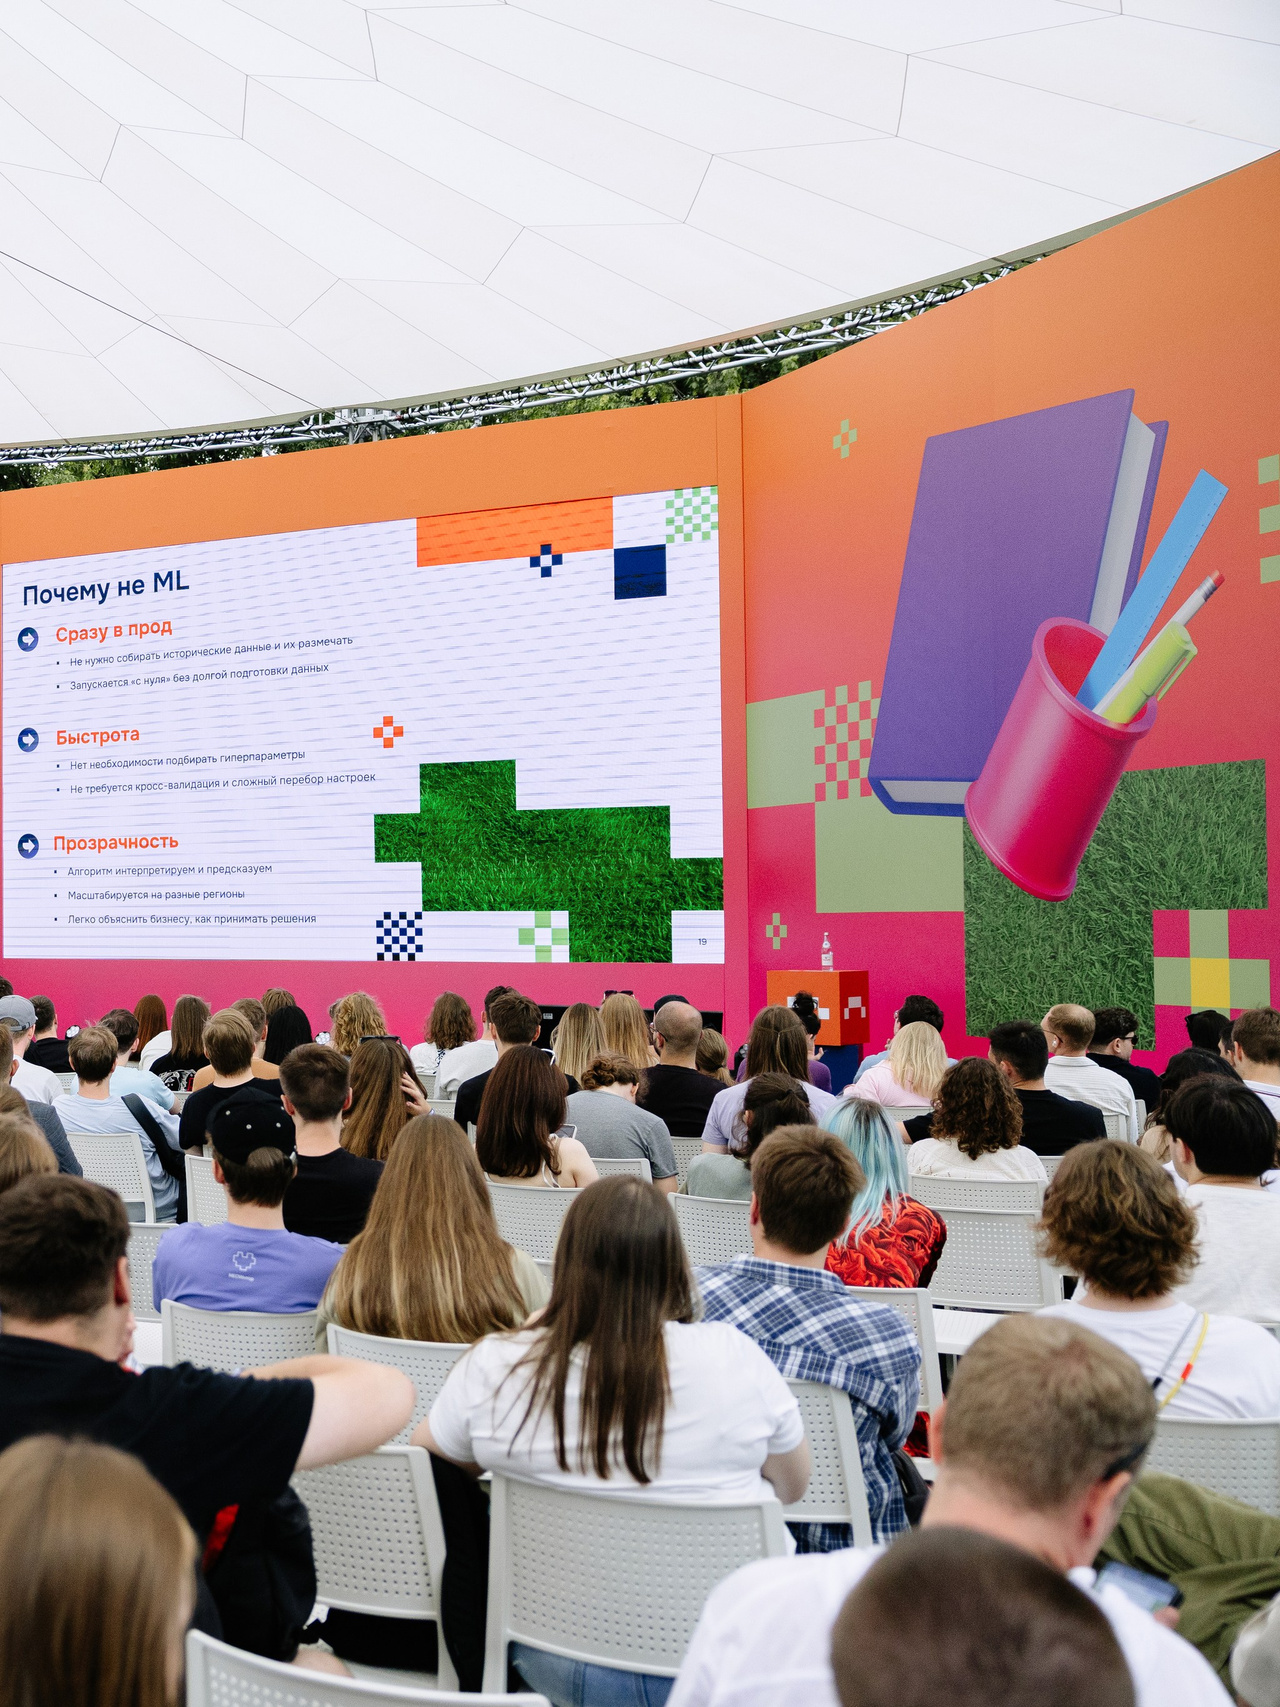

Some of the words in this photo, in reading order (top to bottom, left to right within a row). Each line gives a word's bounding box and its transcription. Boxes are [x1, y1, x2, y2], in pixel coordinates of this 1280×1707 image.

[23, 582, 111, 606] Почему
[117, 578, 145, 597] не
[153, 569, 190, 593] ML
[55, 626, 109, 646] Сразу
[113, 625, 123, 638] в
[128, 620, 173, 640] прод
[69, 657, 83, 667] Не
[84, 656, 115, 668] нужно
[116, 652, 161, 663] собирать
[163, 646, 232, 660] исторические
[234, 643, 272, 655] данные
[274, 642, 281, 650] и
[283, 641, 296, 650] их
[298, 637, 354, 651] размечать
[70, 679, 129, 692] Запускается
[130, 678, 142, 686] «с
[143, 676, 171, 687] нуля»
[172, 673, 191, 683] без
[192, 669, 228, 683] долгой
[230, 667, 289, 680] подготовки
[290, 664, 329, 676] данных
[56, 729, 140, 747] Быстрота
[70, 760, 88, 770] Нет
[89, 758, 164, 769] необходимости
[165, 754, 218, 767] подбирать
[219, 751, 306, 764] гиперпараметры
[70, 785, 83, 794] Не
[85, 783, 133, 795] требуется
[135, 780, 220, 793] кросс-валидация
[222, 780, 229, 788] и
[231, 775, 277, 788] сложный
[279, 774, 324, 787] перебор
[326, 773, 376, 785] настроек
[53, 835, 179, 855] Прозрачность
[67, 866, 113, 878] Алгоритм
[115, 866, 196, 878] интерпретируем
[197, 866, 204, 874] и
[206, 865, 273, 876] предсказуем
[68, 890, 149, 902] Масштабируется
[151, 891, 163, 900] на
[164, 891, 201, 901] разные
[202, 890, 245, 901] регионы
[67, 914, 96, 924] Легко
[98, 914, 148, 924] объяснить
[149, 914, 193, 927] бизнесу,
[194, 915, 212, 924] как
[214, 915, 269, 926] принимать
[270, 915, 317, 926] решения
[697, 937, 708, 946] 19
